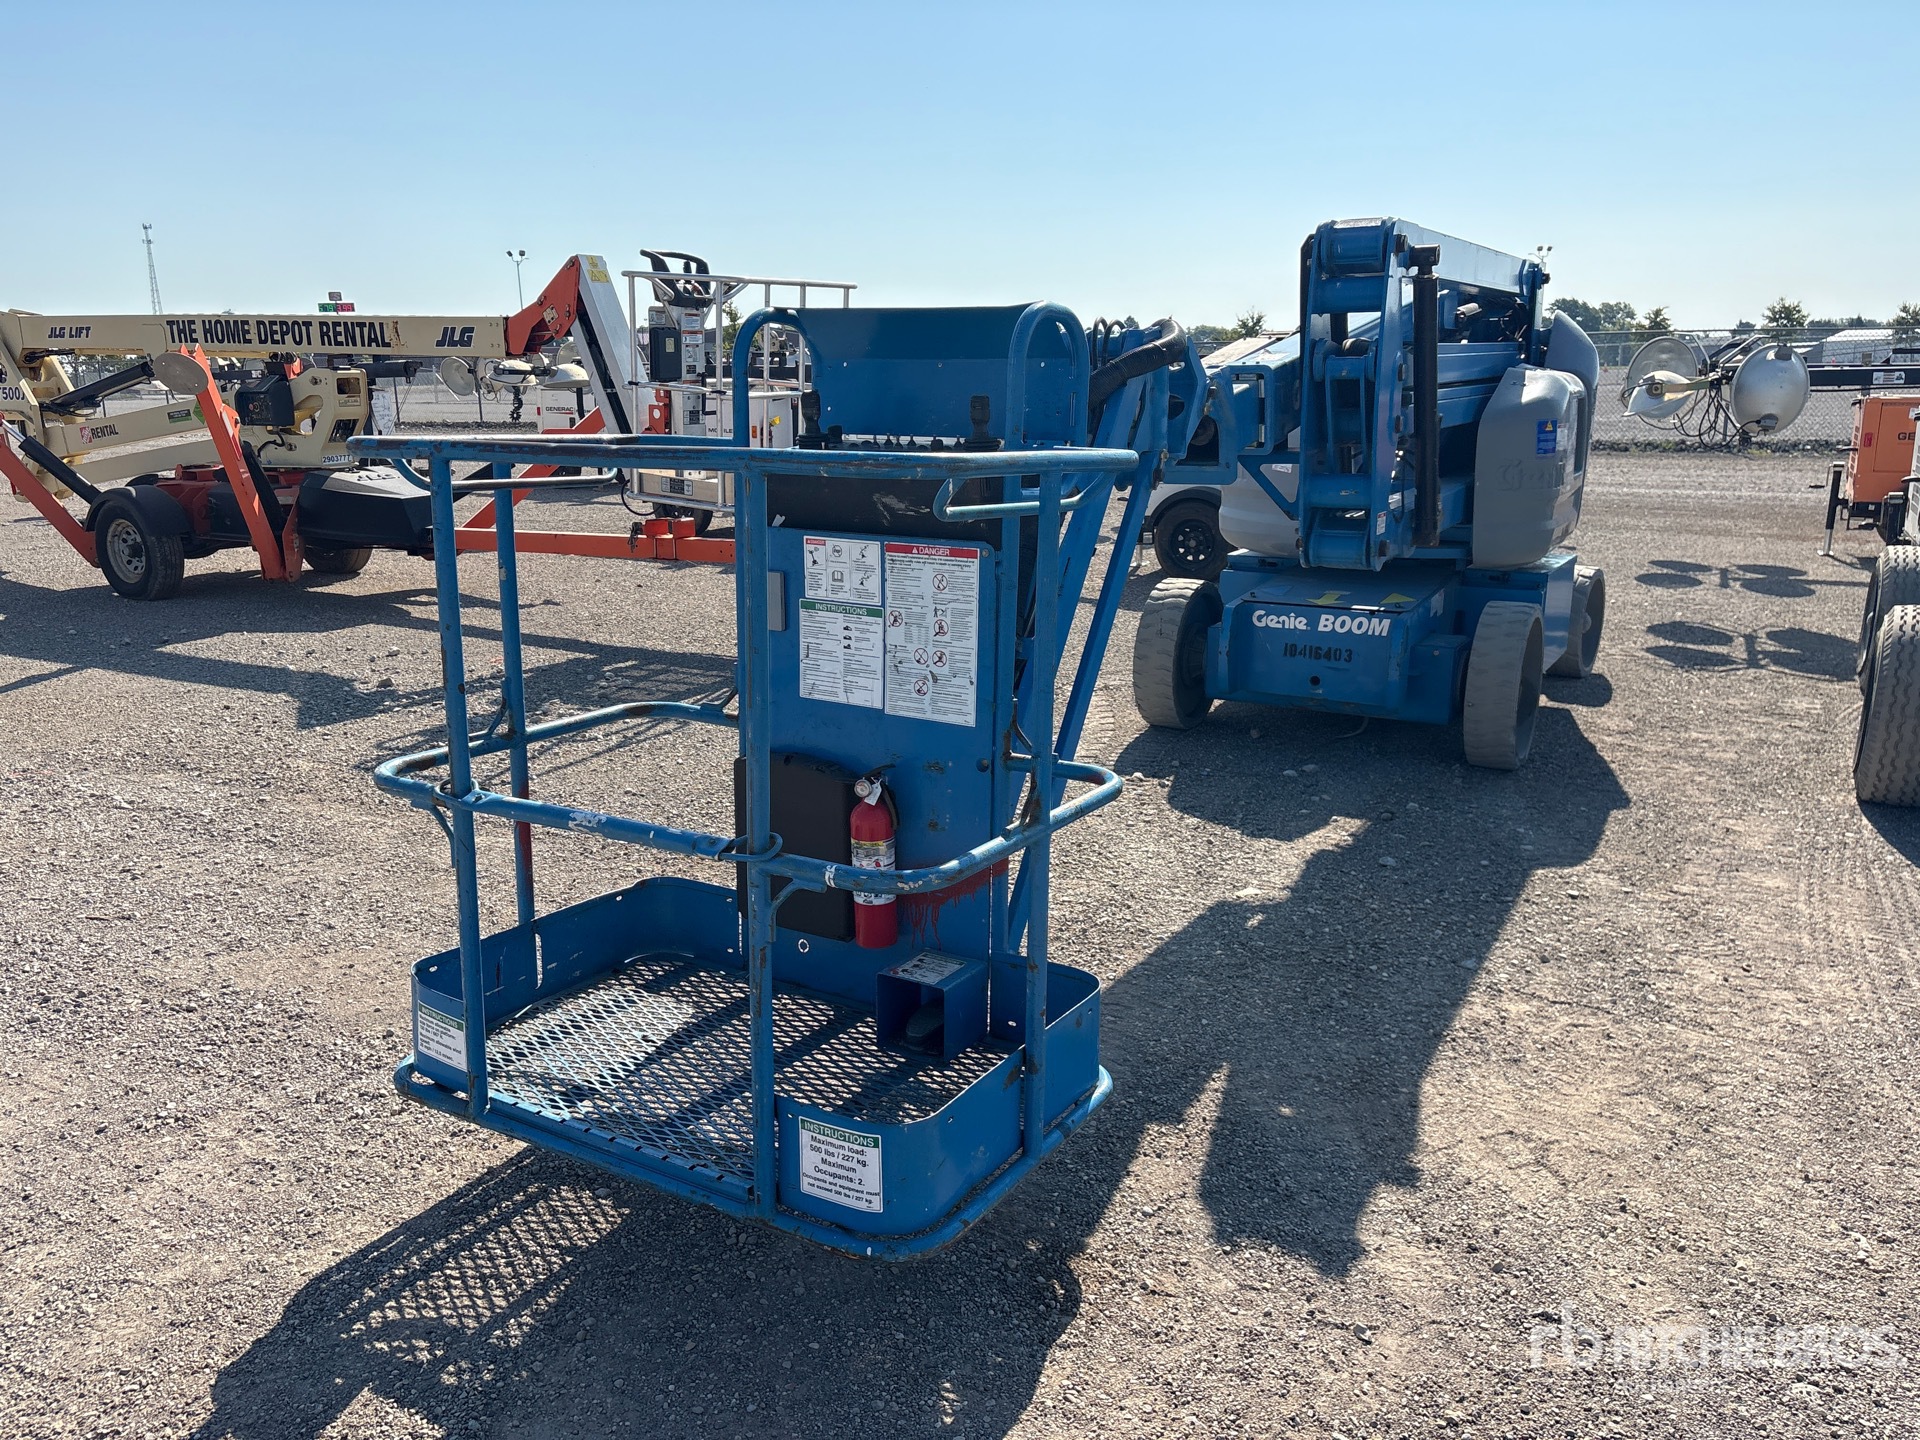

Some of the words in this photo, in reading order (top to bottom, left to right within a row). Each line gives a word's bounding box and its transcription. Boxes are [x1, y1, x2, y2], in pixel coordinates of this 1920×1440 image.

[48, 326, 66, 339] JLG
[68, 326, 91, 339] LIFT
[166, 319, 198, 344] THE
[201, 319, 252, 345] HOME
[255, 320, 313, 346] DEPOT
[318, 321, 392, 348] RENTAL
[435, 326, 475, 348] JLG
[90, 423, 119, 440] RENTAL
[918, 546, 950, 556] DANGER
[815, 603, 868, 616] INSTRUCTIONS
[1317, 613, 1391, 637] BOOM
[421, 1006, 458, 1029] INSTRUCTIONS
[804, 1121, 875, 1147] INSTRUCTIONS
[809, 1144, 823, 1154] 500
[824, 1147, 835, 1158] lbs
[841, 1153, 855, 1163] 227
[856, 1157, 870, 1168] kg.
[810, 1135, 846, 1151] Maximum
[847, 1145, 867, 1157] load:
[813, 1165, 857, 1184] Occupants:
[857, 1178, 865, 1187] 2.
[821, 1157, 857, 1174] Maximum
